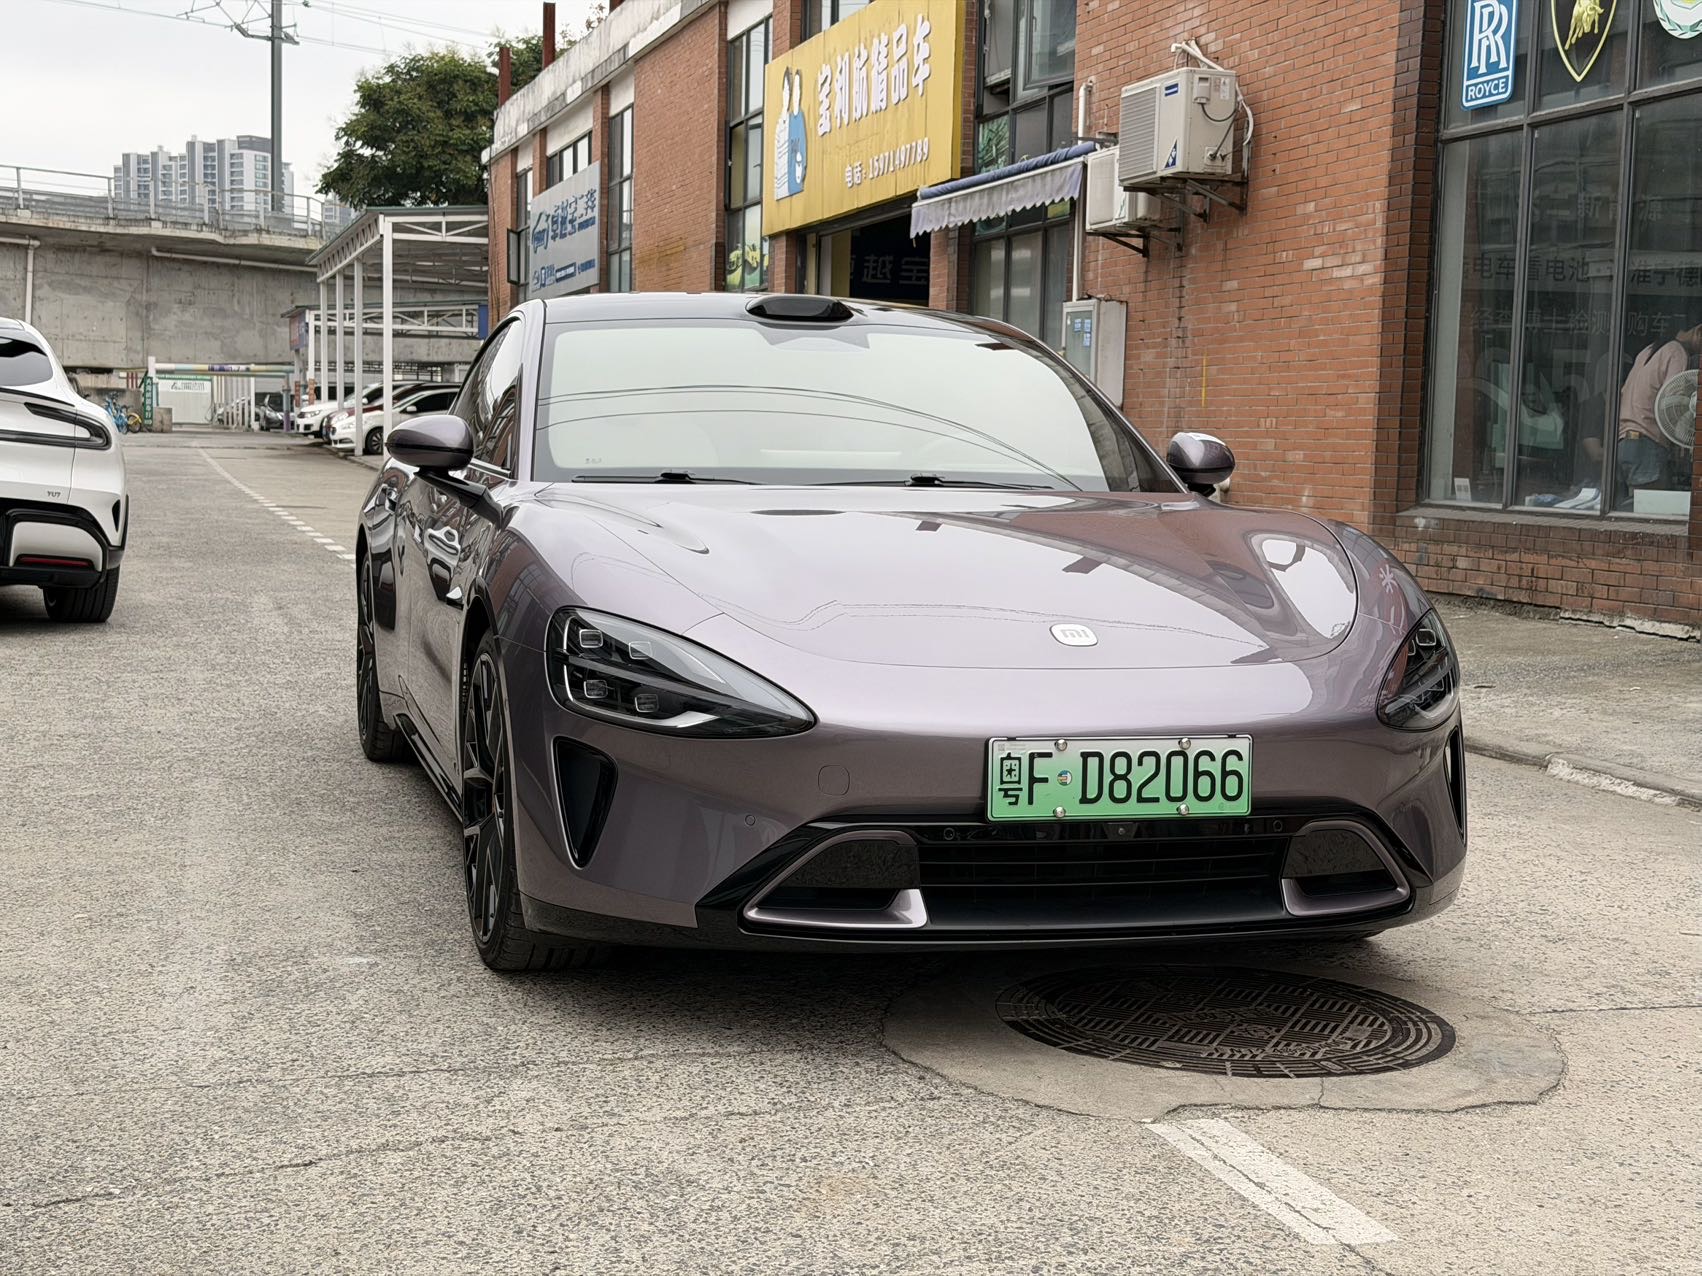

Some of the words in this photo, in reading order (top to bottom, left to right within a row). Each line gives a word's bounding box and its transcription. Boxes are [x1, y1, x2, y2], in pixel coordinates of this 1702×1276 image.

[1467, 78, 1507, 100] ROYCE
[850, 255, 929, 285] 越宝
[47, 490, 61, 499] YU7
[998, 751, 1053, 806] 粤F
[1079, 749, 1244, 804] D82066
